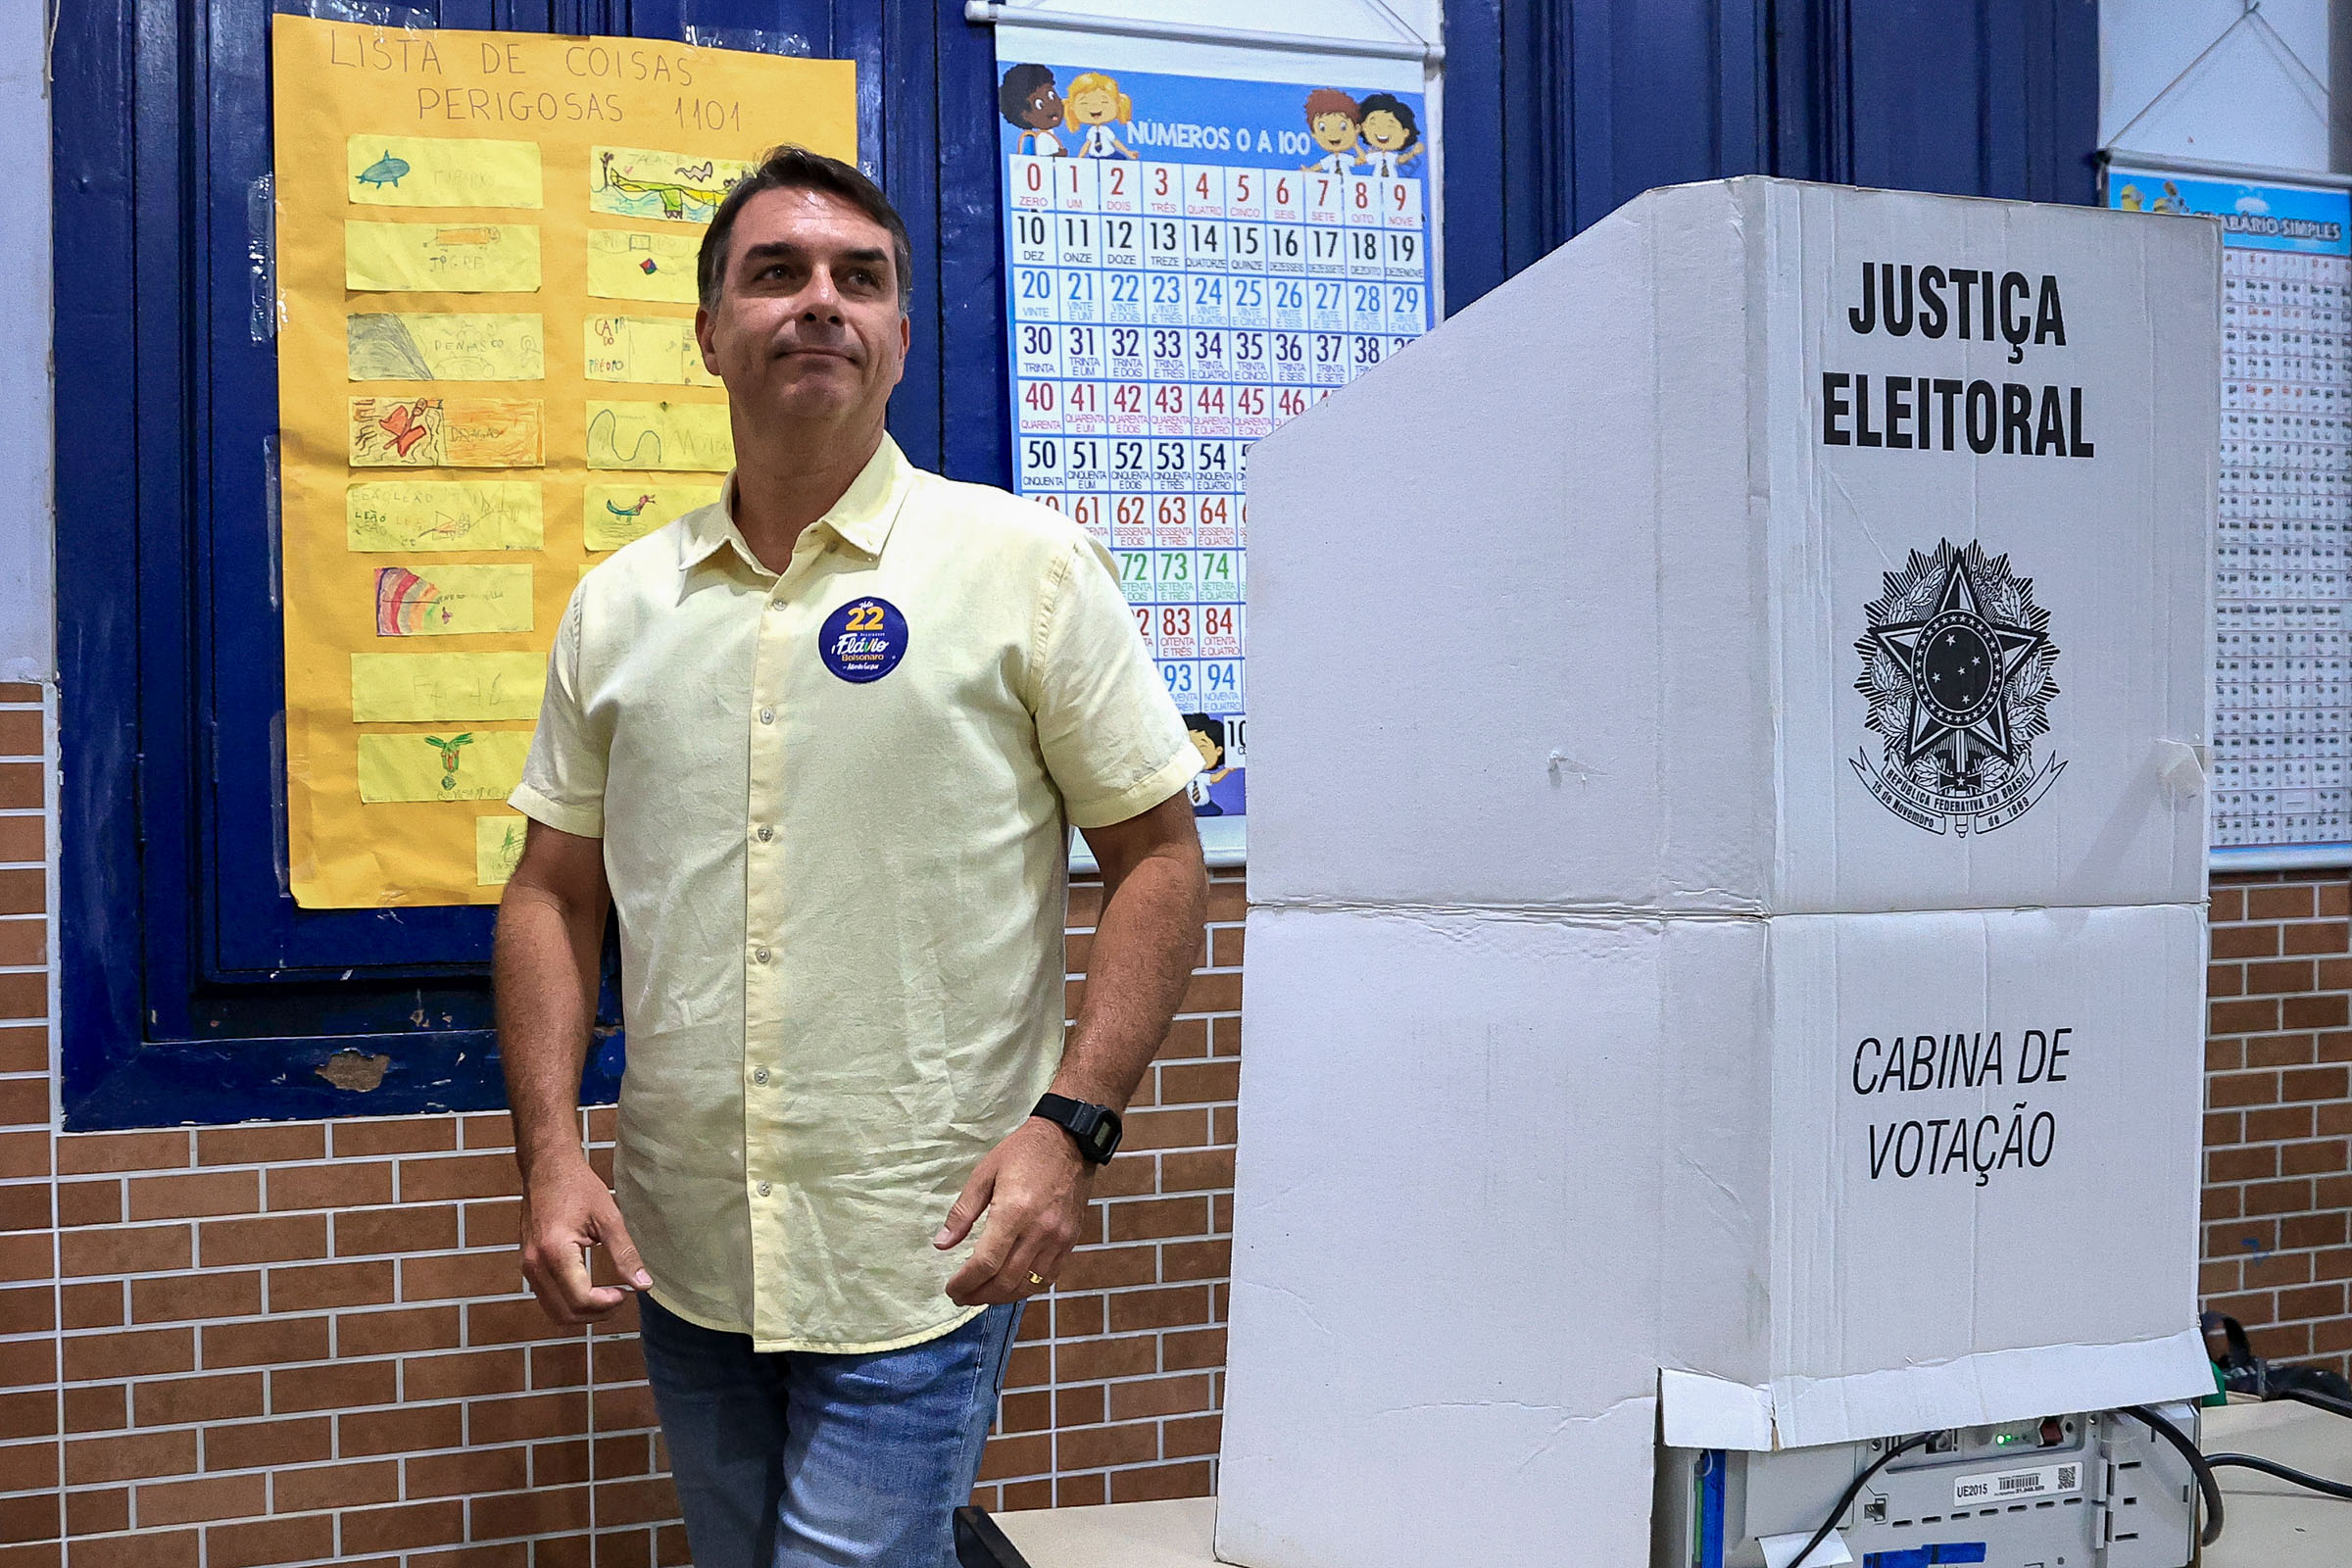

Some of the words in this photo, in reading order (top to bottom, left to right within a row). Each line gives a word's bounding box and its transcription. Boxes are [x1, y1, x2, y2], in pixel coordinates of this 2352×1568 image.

[331, 29, 442, 74] LISTA
[481, 42, 526, 74] DE
[565, 46, 693, 86] COISAS
[418, 87, 623, 122] PERIGOSAS
[1127, 119, 1230, 151] NÚMEROS
[1257, 130, 1272, 153] A
[1278, 130, 1310, 155] 100
[1027, 163, 1041, 191] 0
[1070, 165, 1078, 193] 1
[1110, 168, 1124, 195] 2
[1155, 168, 1168, 196] 3
[1196, 172, 1208, 199] 4
[1237, 174, 1250, 202] 5
[1277, 177, 1289, 204] 6
[1317, 179, 1329, 206] 7
[1355, 182, 1367, 209] 8
[1394, 184, 1406, 211] 9
[1019, 196, 1048, 207] ZERO
[1066, 199, 1082, 208] UM
[1107, 201, 1131, 211] DOIS
[1152, 202, 1176, 213] TRÊS
[1188, 205, 1222, 216] QUATRO
[1275, 210, 1296, 220] SEIS
[1312, 212, 1336, 221] SETE
[1389, 216, 1414, 226] NOVE
[2194, 211, 2278, 236] ABÁRIO
[2281, 219, 2341, 241] SIMPLES
[1018, 217, 1045, 244] 10
[1065, 219, 1088, 246] 11
[1106, 220, 1132, 248] 12
[1151, 222, 1176, 250] 13
[1191, 224, 1217, 252] 14
[1234, 226, 1258, 254] 15
[1273, 228, 1298, 256] 16
[1313, 230, 1338, 258] 17
[1352, 232, 1376, 260] 18
[1391, 234, 1414, 261] 19
[1023, 251, 1044, 261] DEZ
[1063, 253, 1092, 263] ONZE
[1107, 255, 1136, 265] DOZE
[1152, 257, 1179, 267] TREZE
[1022, 270, 1051, 299] 20
[1068, 272, 1093, 301] 21
[1110, 274, 1139, 302] 22
[1152, 275, 1180, 304] 23
[1195, 277, 1222, 305] 24
[1236, 279, 1261, 307] 25
[1276, 281, 1302, 308] 26
[1316, 283, 1342, 310] 27
[1354, 285, 1380, 312] 28
[1394, 286, 1418, 313] 29
[1023, 308, 1049, 318] VINTE
[1848, 262, 2067, 364] JUSTIÇA
[1023, 326, 1052, 355] 30
[1070, 327, 1094, 355] 31
[1112, 328, 1140, 357] 32
[1153, 330, 1181, 358] 33
[1196, 331, 1222, 359] 34
[1237, 332, 1262, 360] 35
[1276, 333, 1301, 362] 36
[1317, 335, 1342, 363] 37
[1354, 336, 1380, 364] 38
[1024, 363, 1055, 372] TRINTA
[1069, 357, 1100, 367] TRINTA
[1113, 358, 1144, 368] TRINTA
[1026, 382, 1054, 411] 40
[1071, 384, 1095, 412] 41
[1113, 385, 1141, 413] 42
[1155, 385, 1183, 414] 43
[1198, 386, 1224, 414] 44
[1239, 387, 1264, 415] 45
[1279, 389, 1304, 416] 46
[1021, 420, 1061, 430] QUARENTA
[1823, 371, 2094, 458] ELEITORAL
[1028, 440, 1055, 468] 50
[1073, 442, 1097, 468] 51
[1115, 442, 1143, 469] 52
[1156, 442, 1184, 470] 53
[1199, 443, 1225, 470] 54
[1023, 476, 1064, 487] CINQUENTA
[1067, 471, 1106, 481] CINQUENTA
[1111, 471, 1151, 481] CINQUENTA
[1196, 472, 1232, 482] CINQUENTA
[1075, 496, 1099, 524] 61
[1117, 496, 1145, 524] 62
[1158, 497, 1186, 524] 63
[1200, 497, 1227, 524] 64
[1121, 554, 1147, 580] 72
[1161, 554, 1187, 580] 73
[1203, 553, 1229, 580] 74
[846, 607, 885, 631] 22
[1162, 608, 1191, 636] 83
[1205, 608, 1233, 635] 84
[835, 633, 890, 655] Flávio
[1160, 637, 1195, 647] OITENTA
[1204, 637, 1237, 646] OITENTA
[1163, 648, 1168, 657] E
[1170, 647, 1192, 657] TRÊS
[842, 653, 884, 662] Bolsonaro
[1164, 663, 1192, 692] 93
[1207, 663, 1235, 691] 94
[1872, 780, 1883, 793] 15
[1882, 790, 1892, 803] de
[1892, 800, 1935, 828] Novembro
[1988, 815, 2000, 827] de
[1886, 769, 1931, 807] REPÚBLICA
[1935, 800, 1984, 812] FEDERATIVA
[1986, 795, 2000, 808] DO
[2002, 772, 2032, 799] BRASIL
[1853, 1031, 2002, 1095] CABINA
[2017, 1028, 2073, 1084] DE
[1869, 1102, 2056, 1187] VOTAÇÃO
[1956, 1484, 1988, 1497] UE2015
